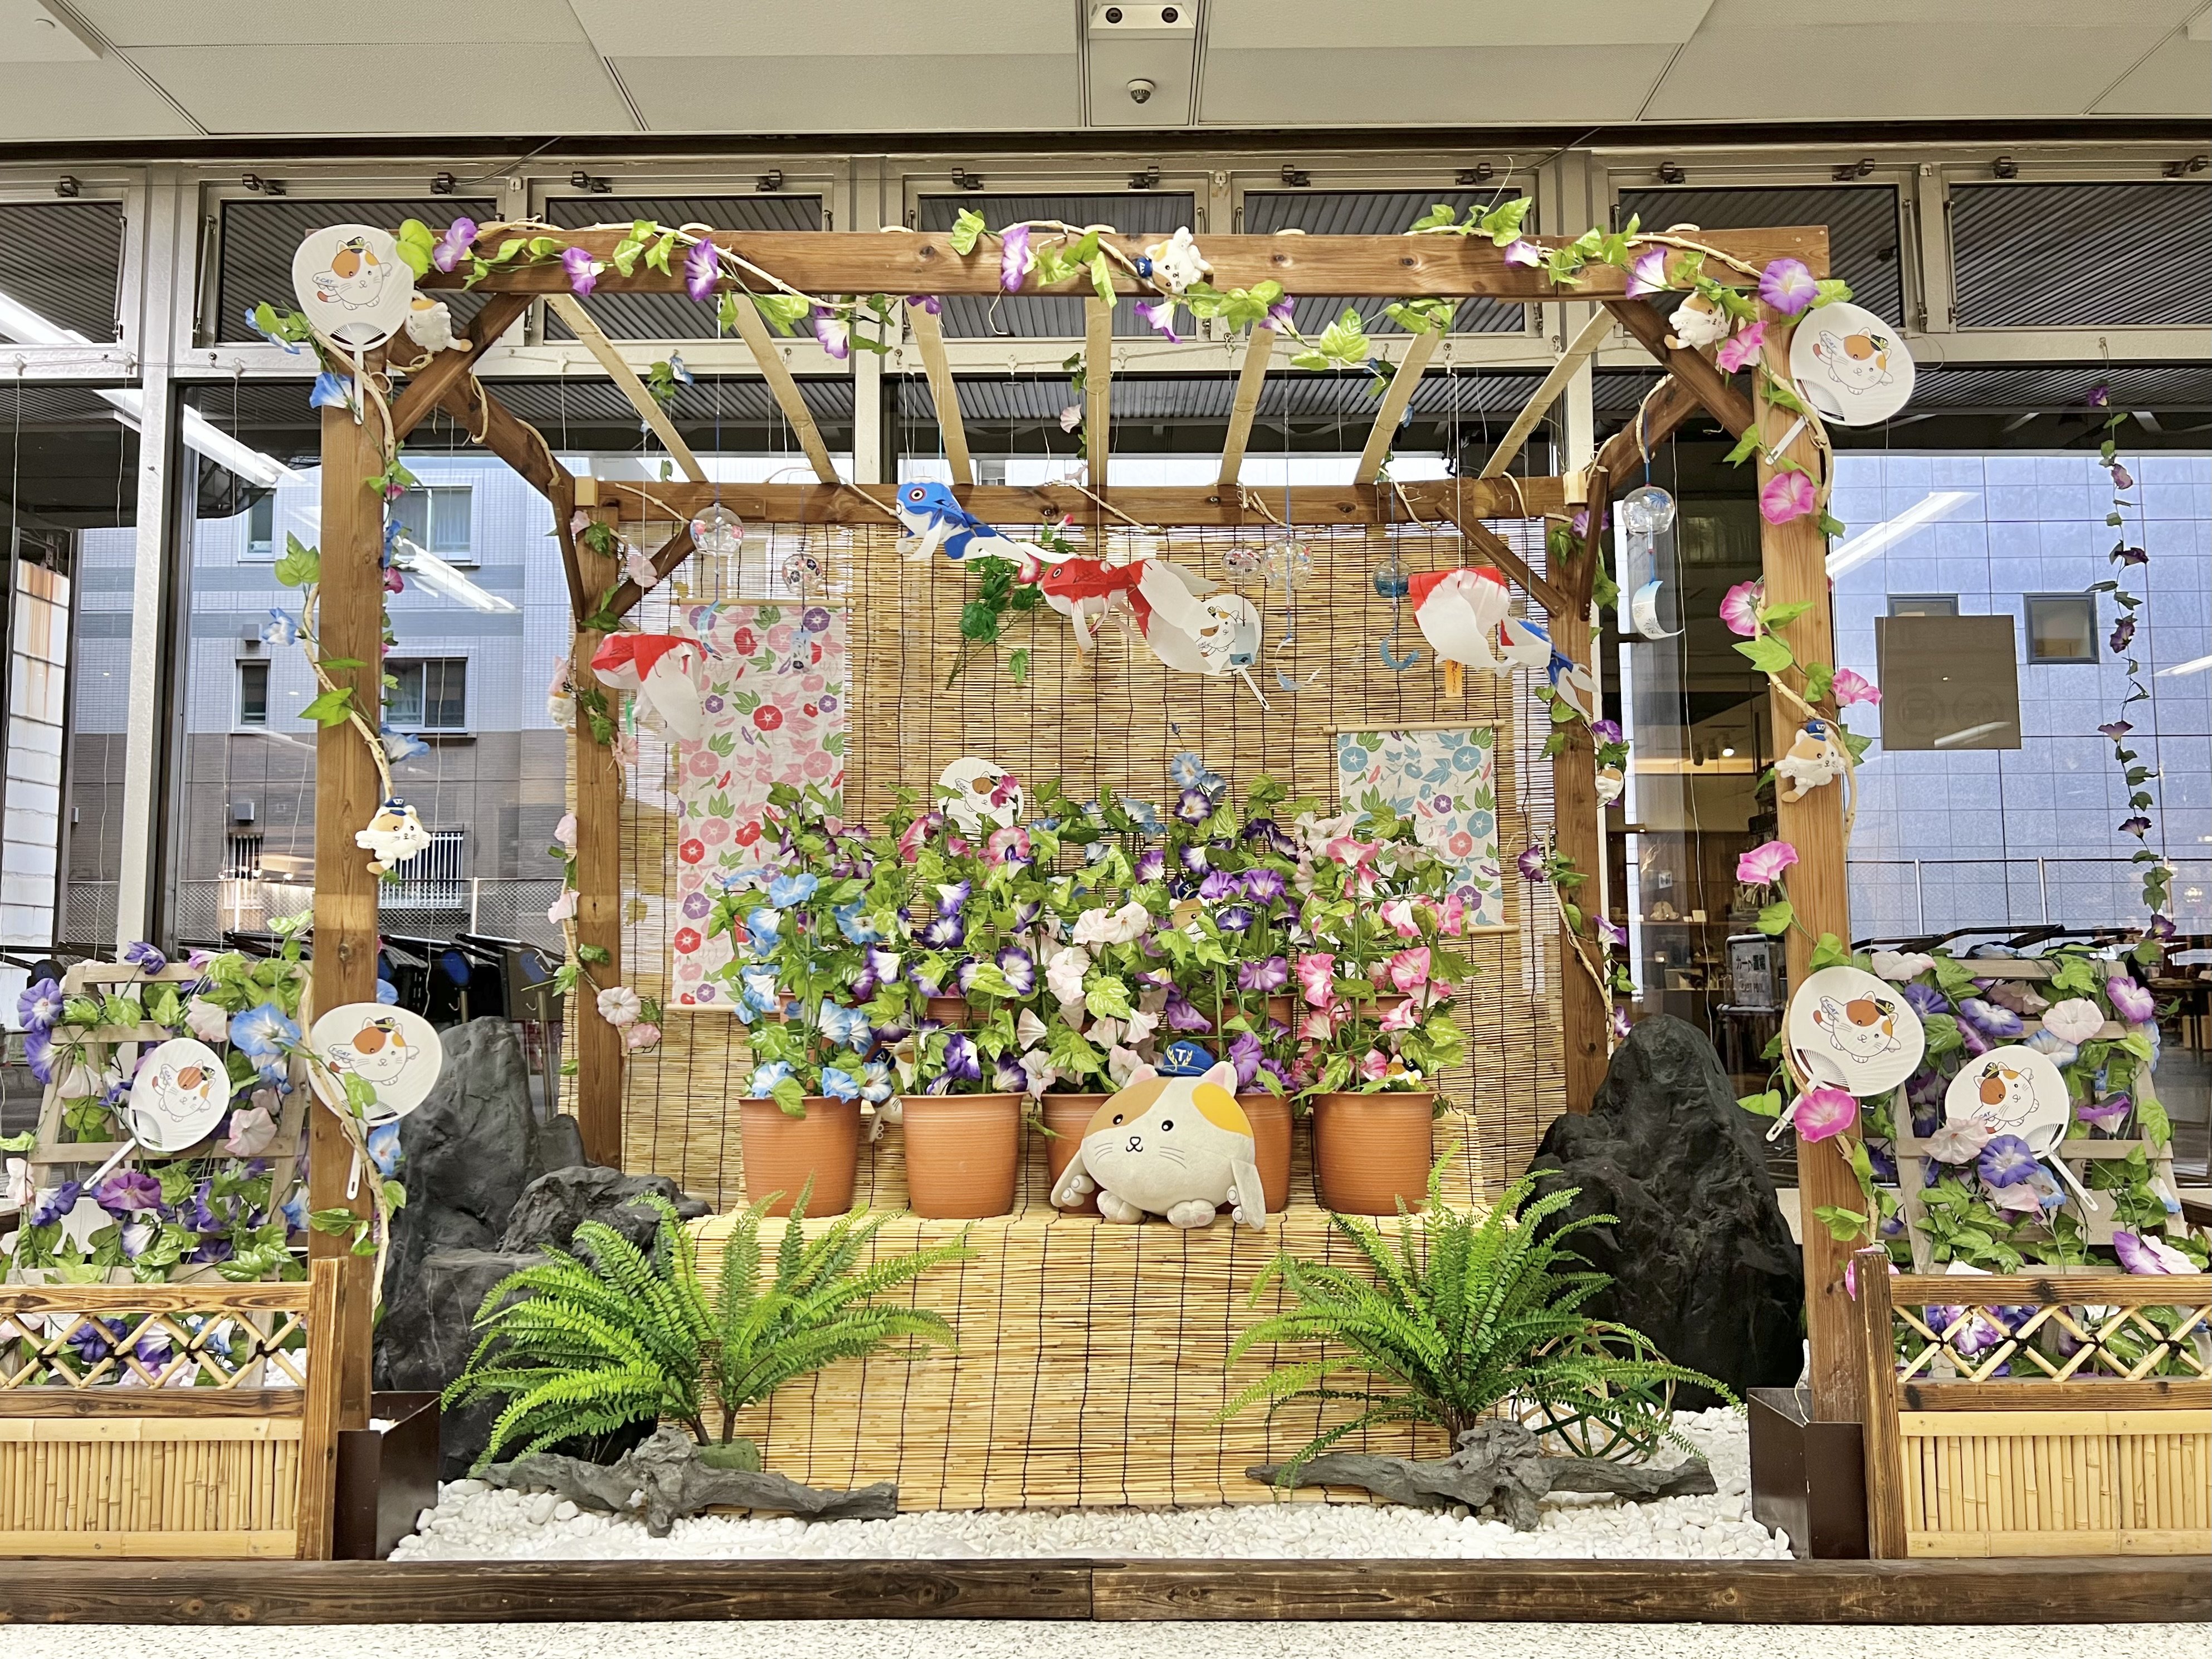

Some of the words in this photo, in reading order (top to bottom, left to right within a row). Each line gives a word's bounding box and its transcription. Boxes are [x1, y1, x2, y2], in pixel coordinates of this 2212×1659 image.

[1823, 998, 1839, 1015] T-CAT
[331, 1047, 351, 1057] T-CAT
[1175, 1048, 1186, 1062] T
